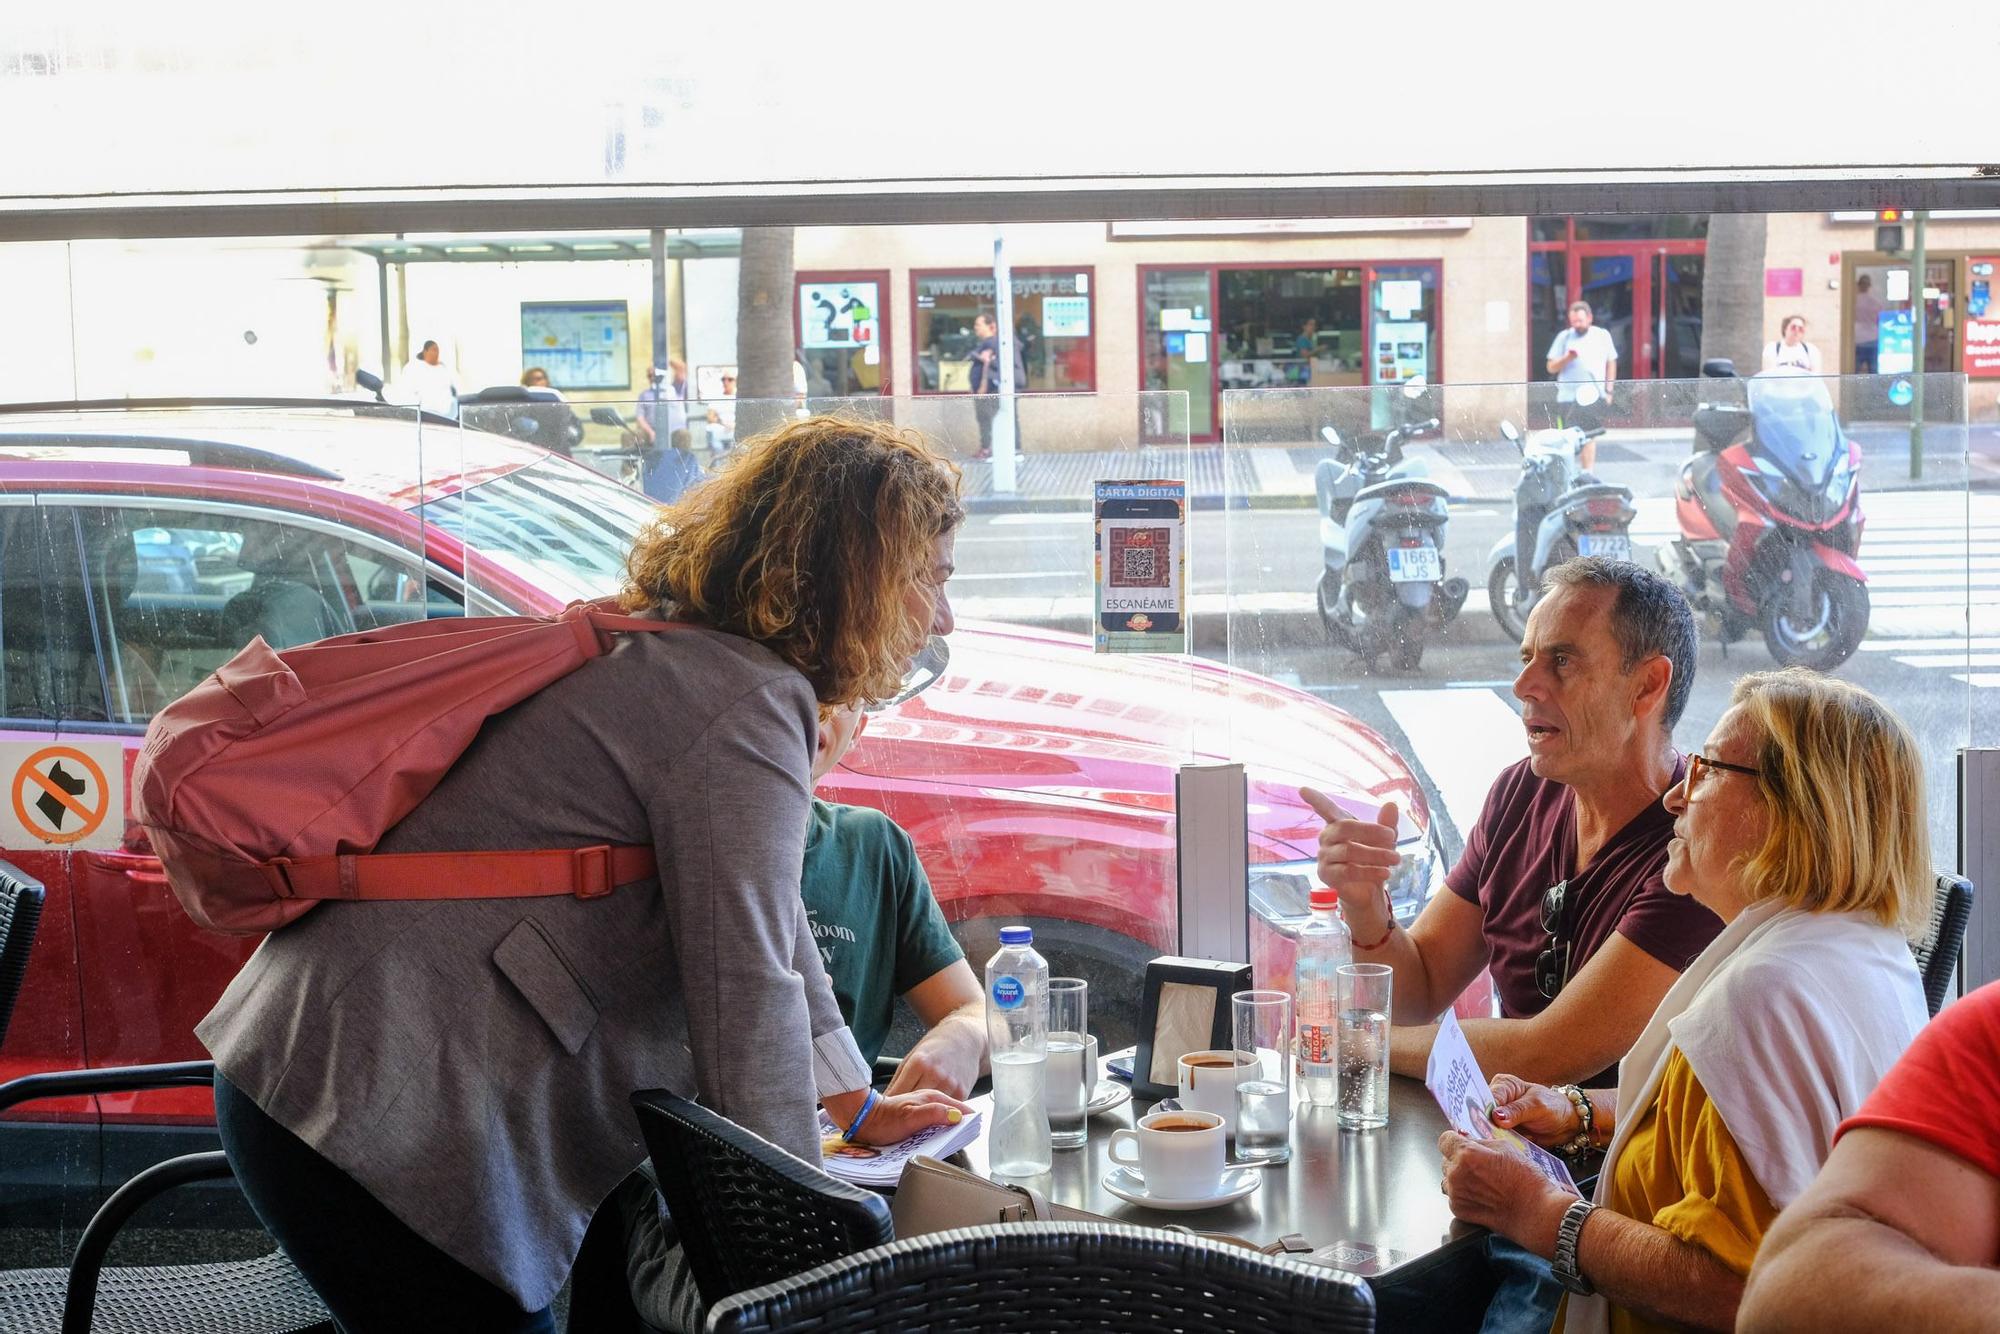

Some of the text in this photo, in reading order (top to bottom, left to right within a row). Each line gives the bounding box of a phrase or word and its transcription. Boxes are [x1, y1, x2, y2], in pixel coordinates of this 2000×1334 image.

[1097, 487, 1183, 497] CARTA DIGITAL
[1591, 537, 1626, 551] 7722
[1402, 551, 1436, 564] 1663
[1402, 565, 1429, 579] LJS
[1106, 597, 1174, 609] ESCANÉAME
